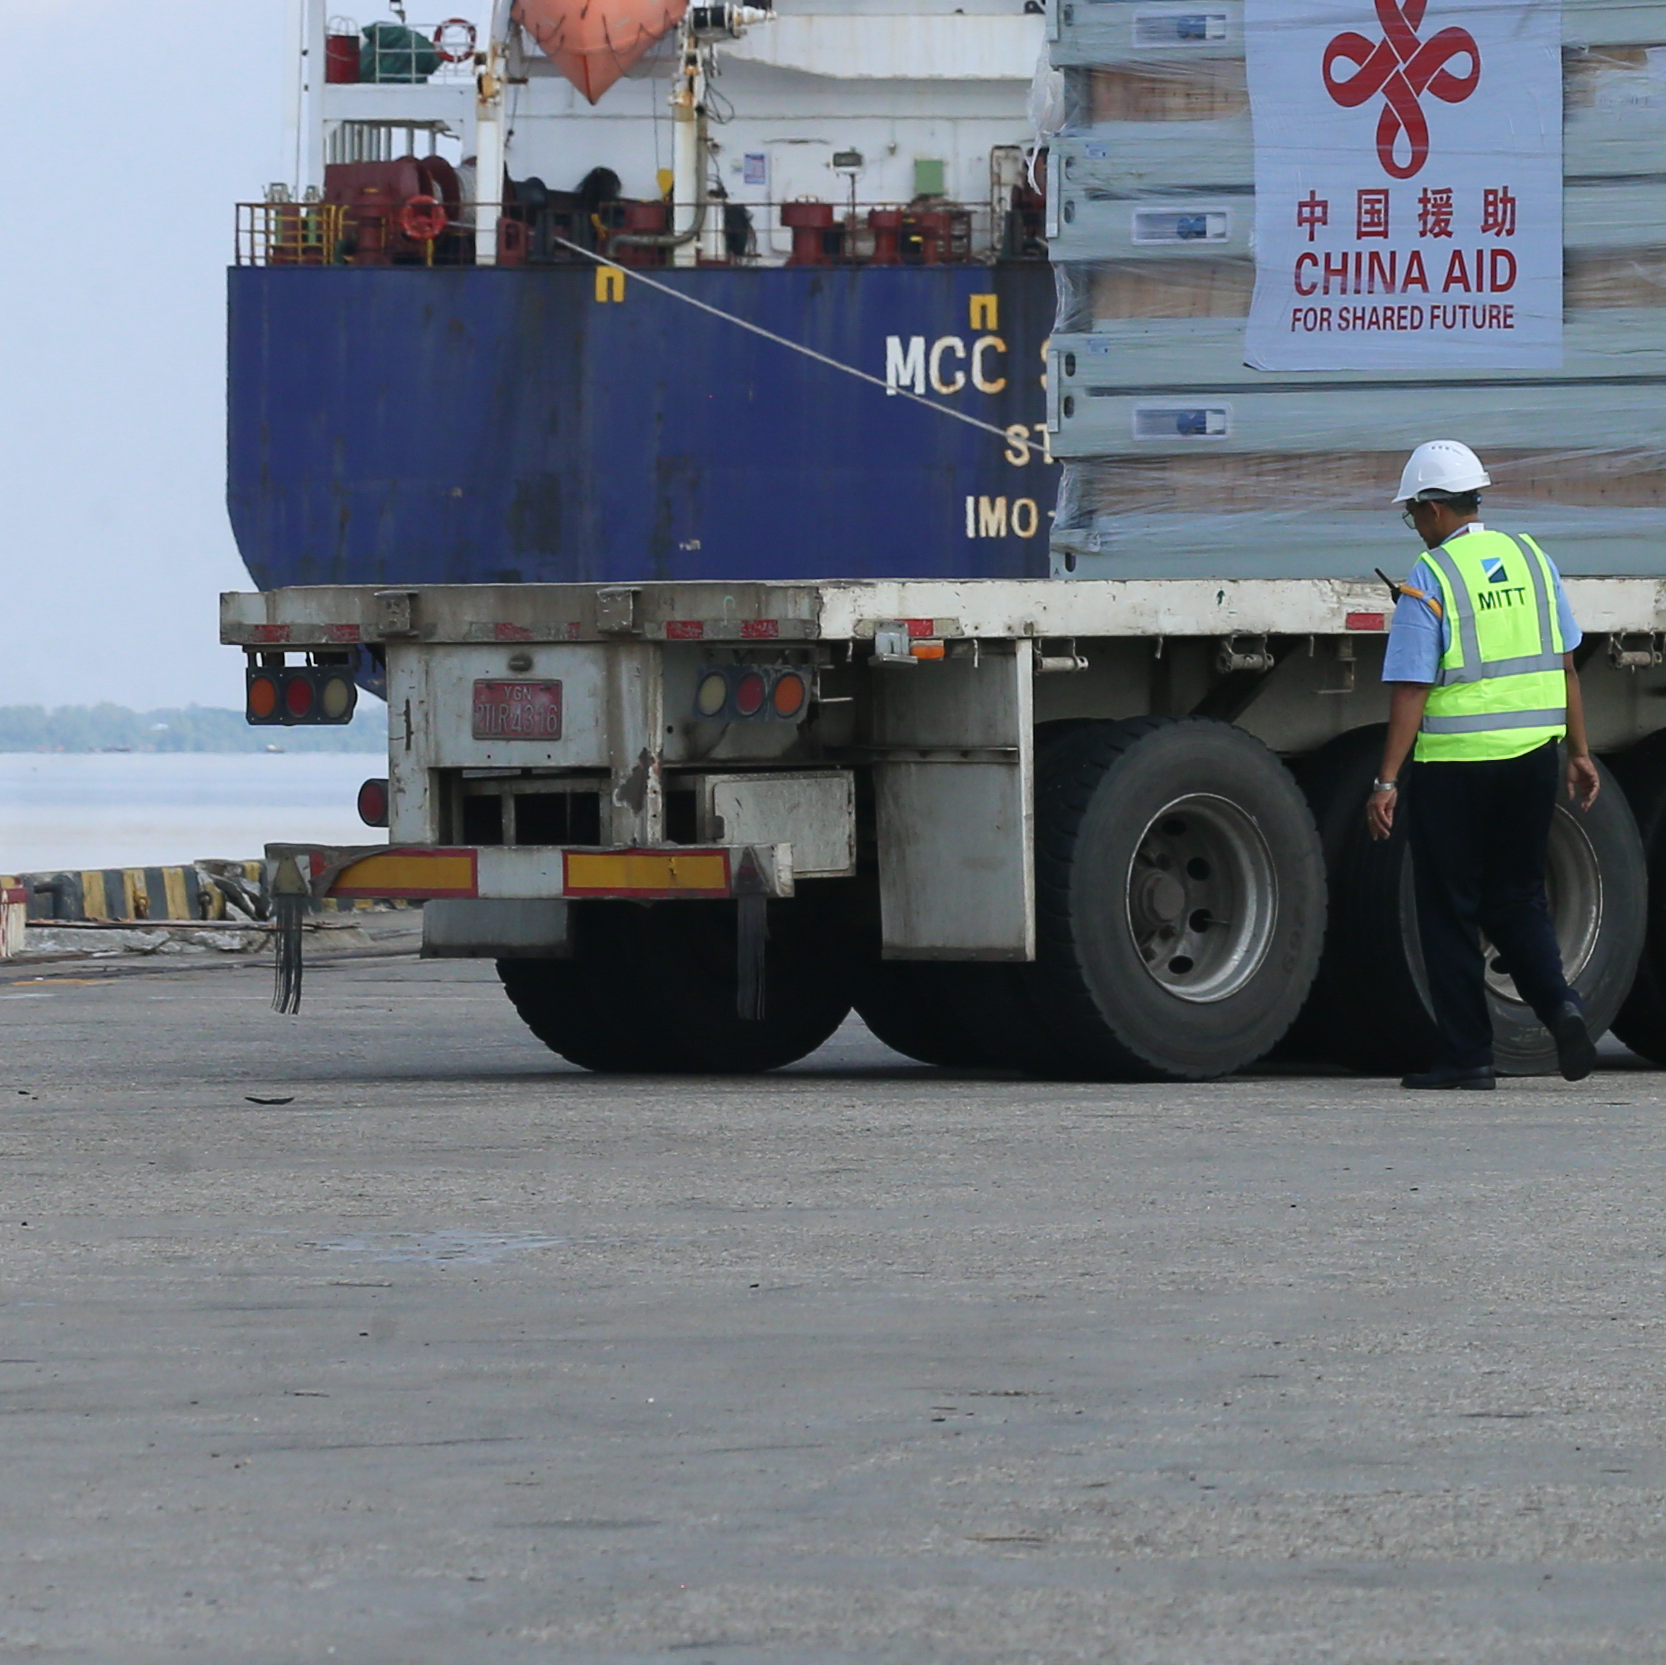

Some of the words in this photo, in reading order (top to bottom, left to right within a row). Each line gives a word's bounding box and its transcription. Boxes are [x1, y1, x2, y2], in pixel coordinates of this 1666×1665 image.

[1297, 186, 1516, 242] 中国援助
[1294, 250, 1430, 296] CHINA
[1442, 248, 1517, 293] AID
[1291, 307, 1332, 332] FOR
[1338, 305, 1424, 331] SHARED
[1430, 304, 1515, 329] FUTURE
[886, 335, 1007, 395] MCC
[966, 495, 1039, 538] IMO
[1478, 587, 1526, 611] MITT
[504, 686, 531, 701] YGN
